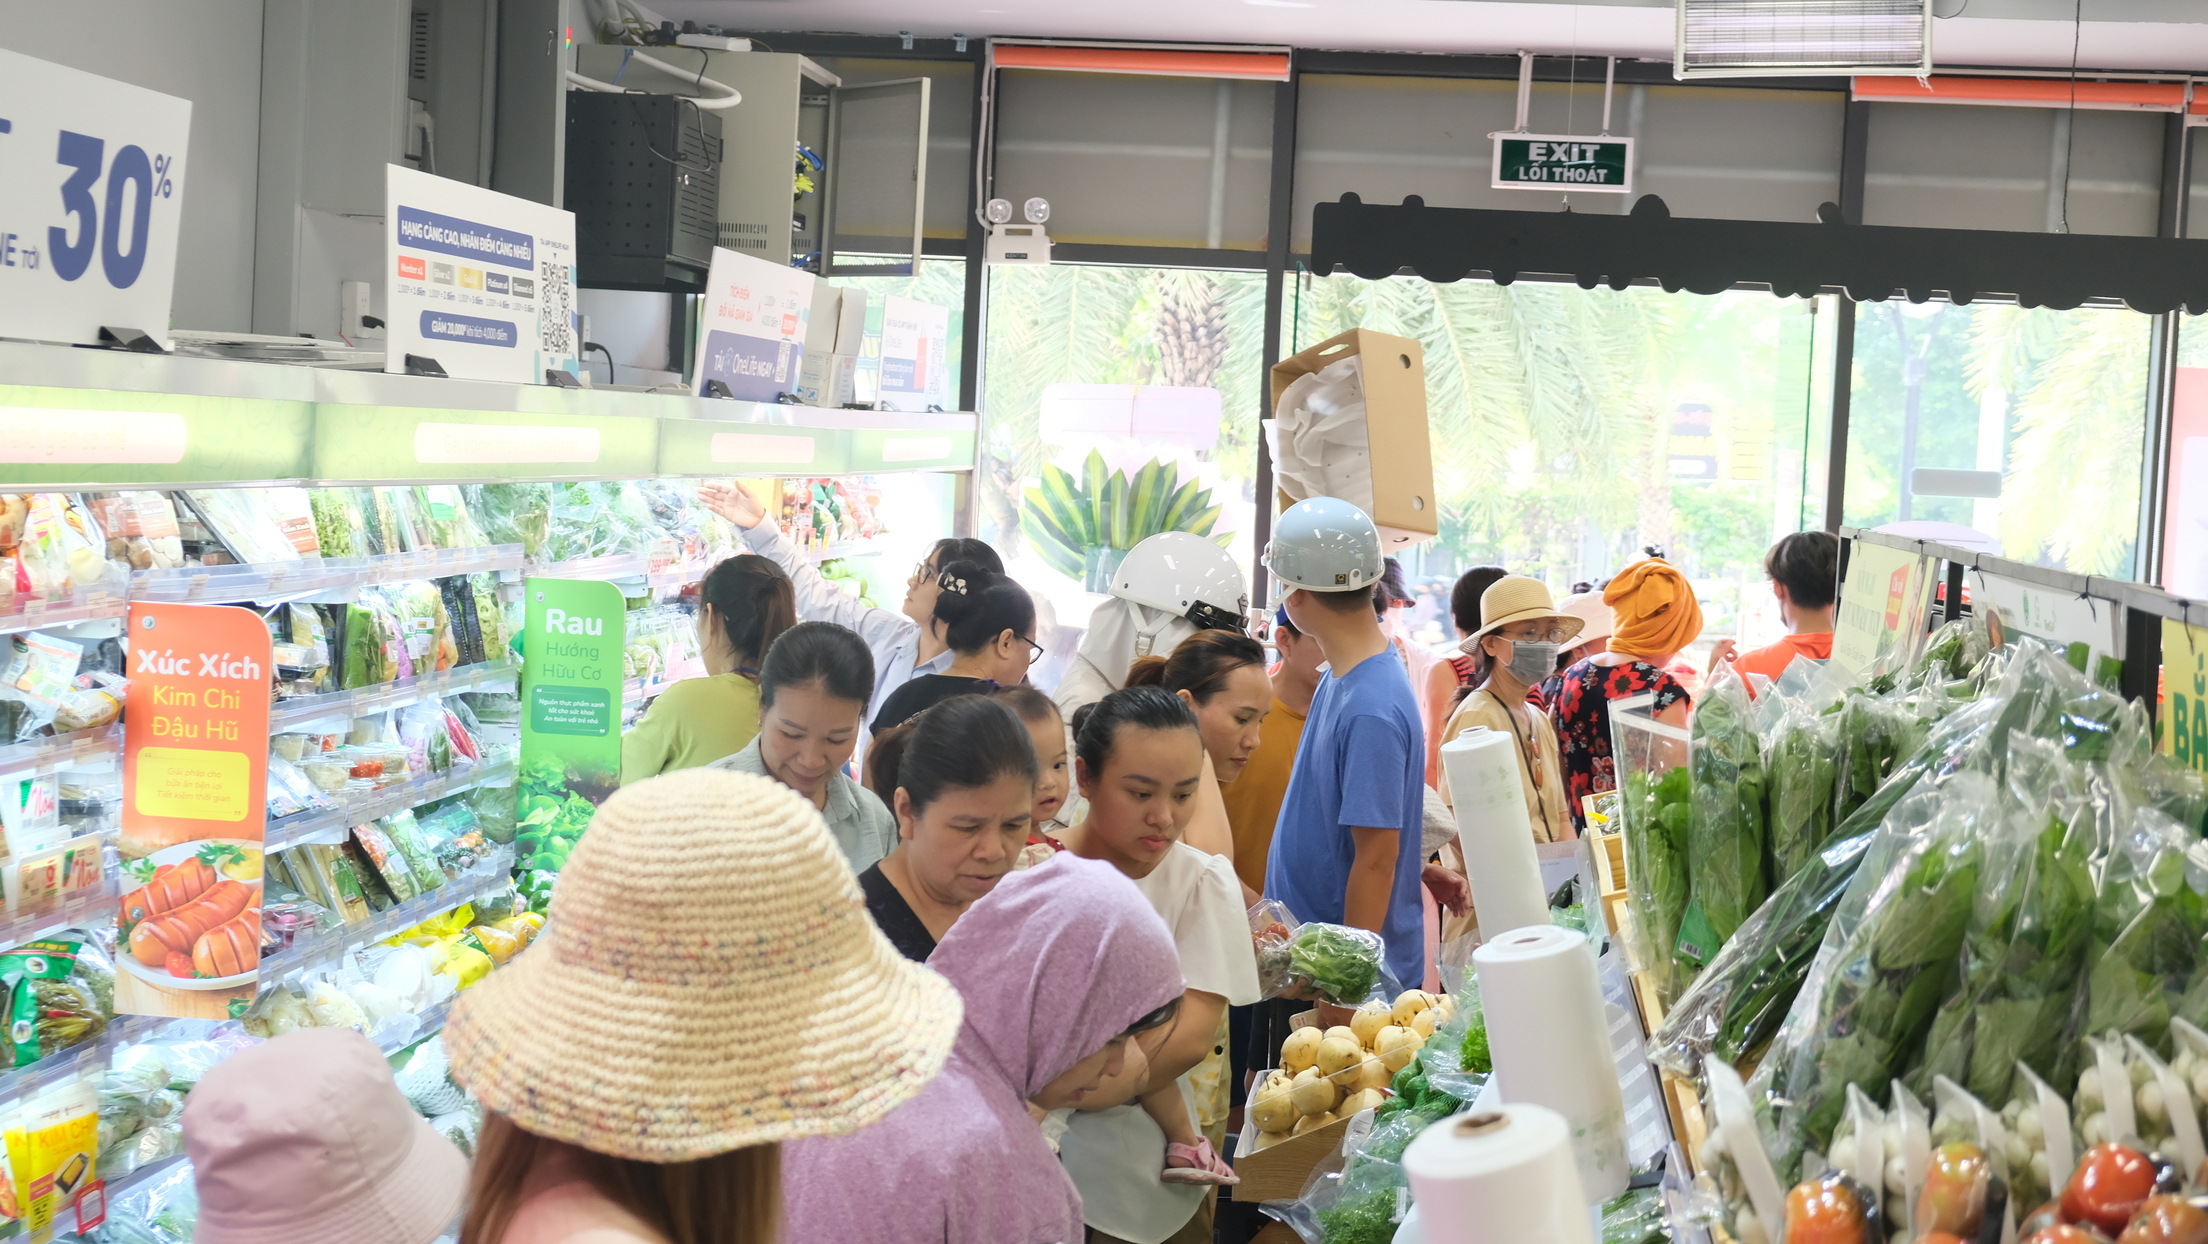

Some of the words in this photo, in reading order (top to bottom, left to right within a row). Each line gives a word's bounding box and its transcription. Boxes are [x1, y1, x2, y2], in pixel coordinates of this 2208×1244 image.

[1528, 142, 1601, 162] EXIT
[1518, 160, 1548, 180] LỐI
[1552, 165, 1608, 183] THOÁT
[401, 219, 423, 241] HẠNG
[423, 222, 443, 245] CÀNG
[443, 228, 459, 248] CAO,
[460, 230, 480, 251] NHÂN
[479, 232, 496, 253] ĐIỂM
[495, 236, 513, 258] CÀNG
[400, 262, 418, 275] Member
[433, 268, 444, 279] Silver
[487, 277, 502, 289] Platinum
[513, 283, 527, 294] Diamond
[431, 317, 447, 333] GIẢM
[496, 326, 508, 341] điểm
[714, 350, 725, 371] TẢI
[732, 352, 759, 377] OneLife
[757, 362, 773, 378] NGAY
[545, 608, 603, 636] Rau
[546, 641, 600, 662] Hướng
[136, 648, 190, 676] Xúc
[198, 652, 260, 680] Xích
[542, 663, 576, 679] Hữu
[580, 665, 602, 681] Cơ
[152, 684, 196, 707] Kim
[203, 688, 241, 710] Chi
[538, 698, 559, 707] Nguồn
[559, 700, 572, 708] thực
[572, 700, 590, 709] phẩm
[548, 706, 557, 714] tốt
[151, 716, 198, 742] Đậu
[206, 719, 239, 741] Hũ
[167, 767, 183, 776] Giải
[184, 768, 205, 778] pháp
[206, 770, 222, 779] cho
[165, 779, 182, 788] bữa
[183, 780, 194, 788] ăn
[194, 780, 211, 790] tiện
[212, 781, 223, 790] lợi
[157, 790, 173, 799] Tiết
[174, 791, 194, 801] kiệm
[195, 792, 212, 802] thời
[212, 794, 231, 804] gian
